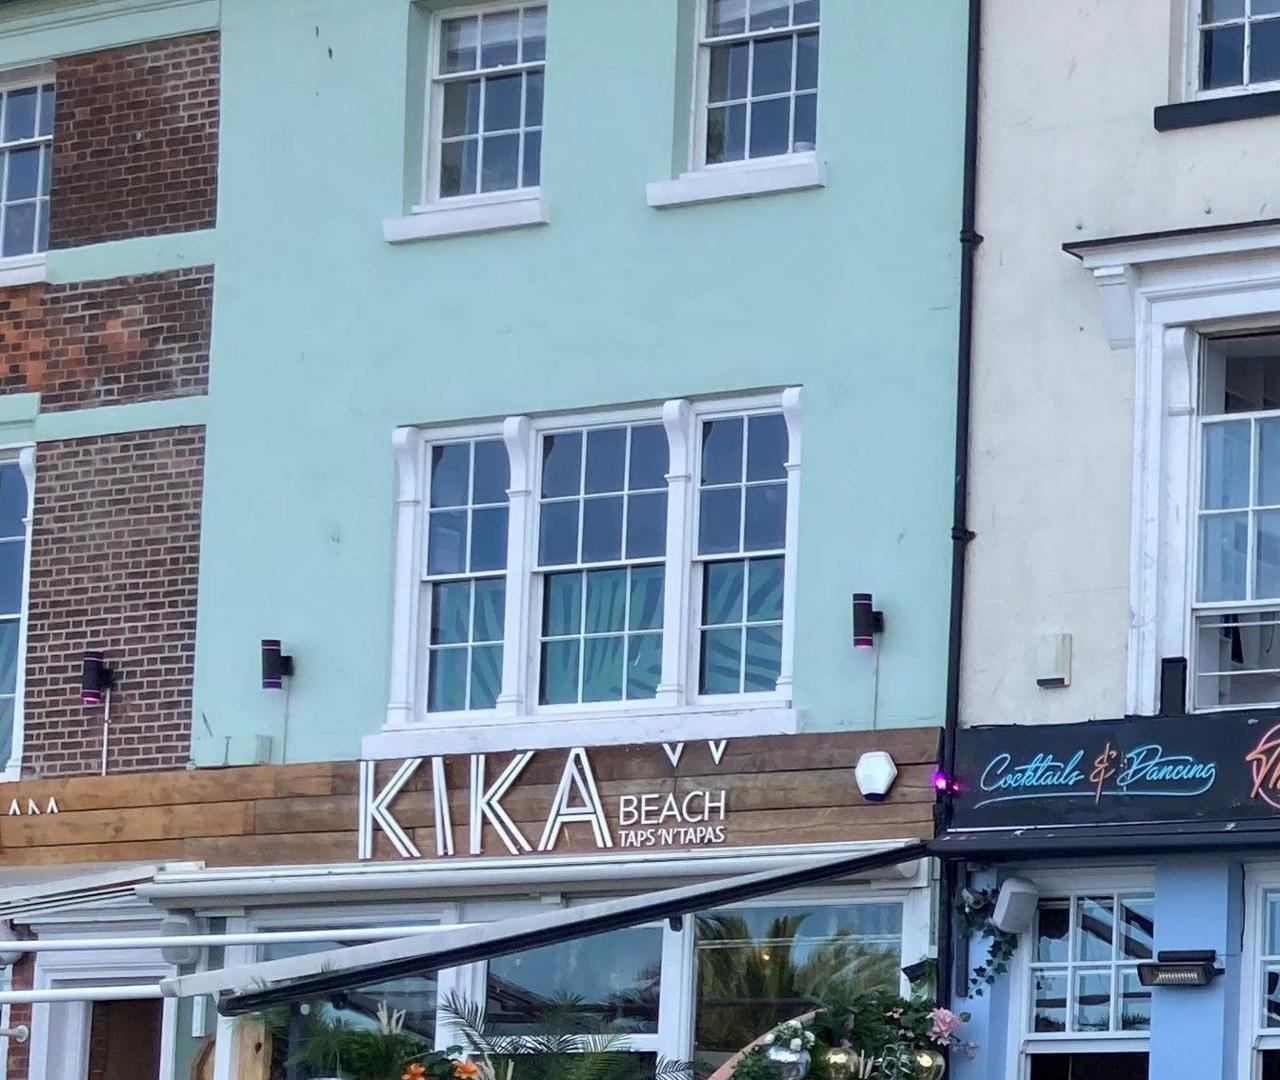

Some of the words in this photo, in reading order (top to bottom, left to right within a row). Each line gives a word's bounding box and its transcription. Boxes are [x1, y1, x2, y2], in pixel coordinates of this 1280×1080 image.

[980, 750, 1084, 791] Cocktails
[1090, 742, 1116, 803] &
[1117, 744, 1216, 795] Dancing
[358, 748, 613, 860] KIKA
[619, 790, 726, 826] BEACH
